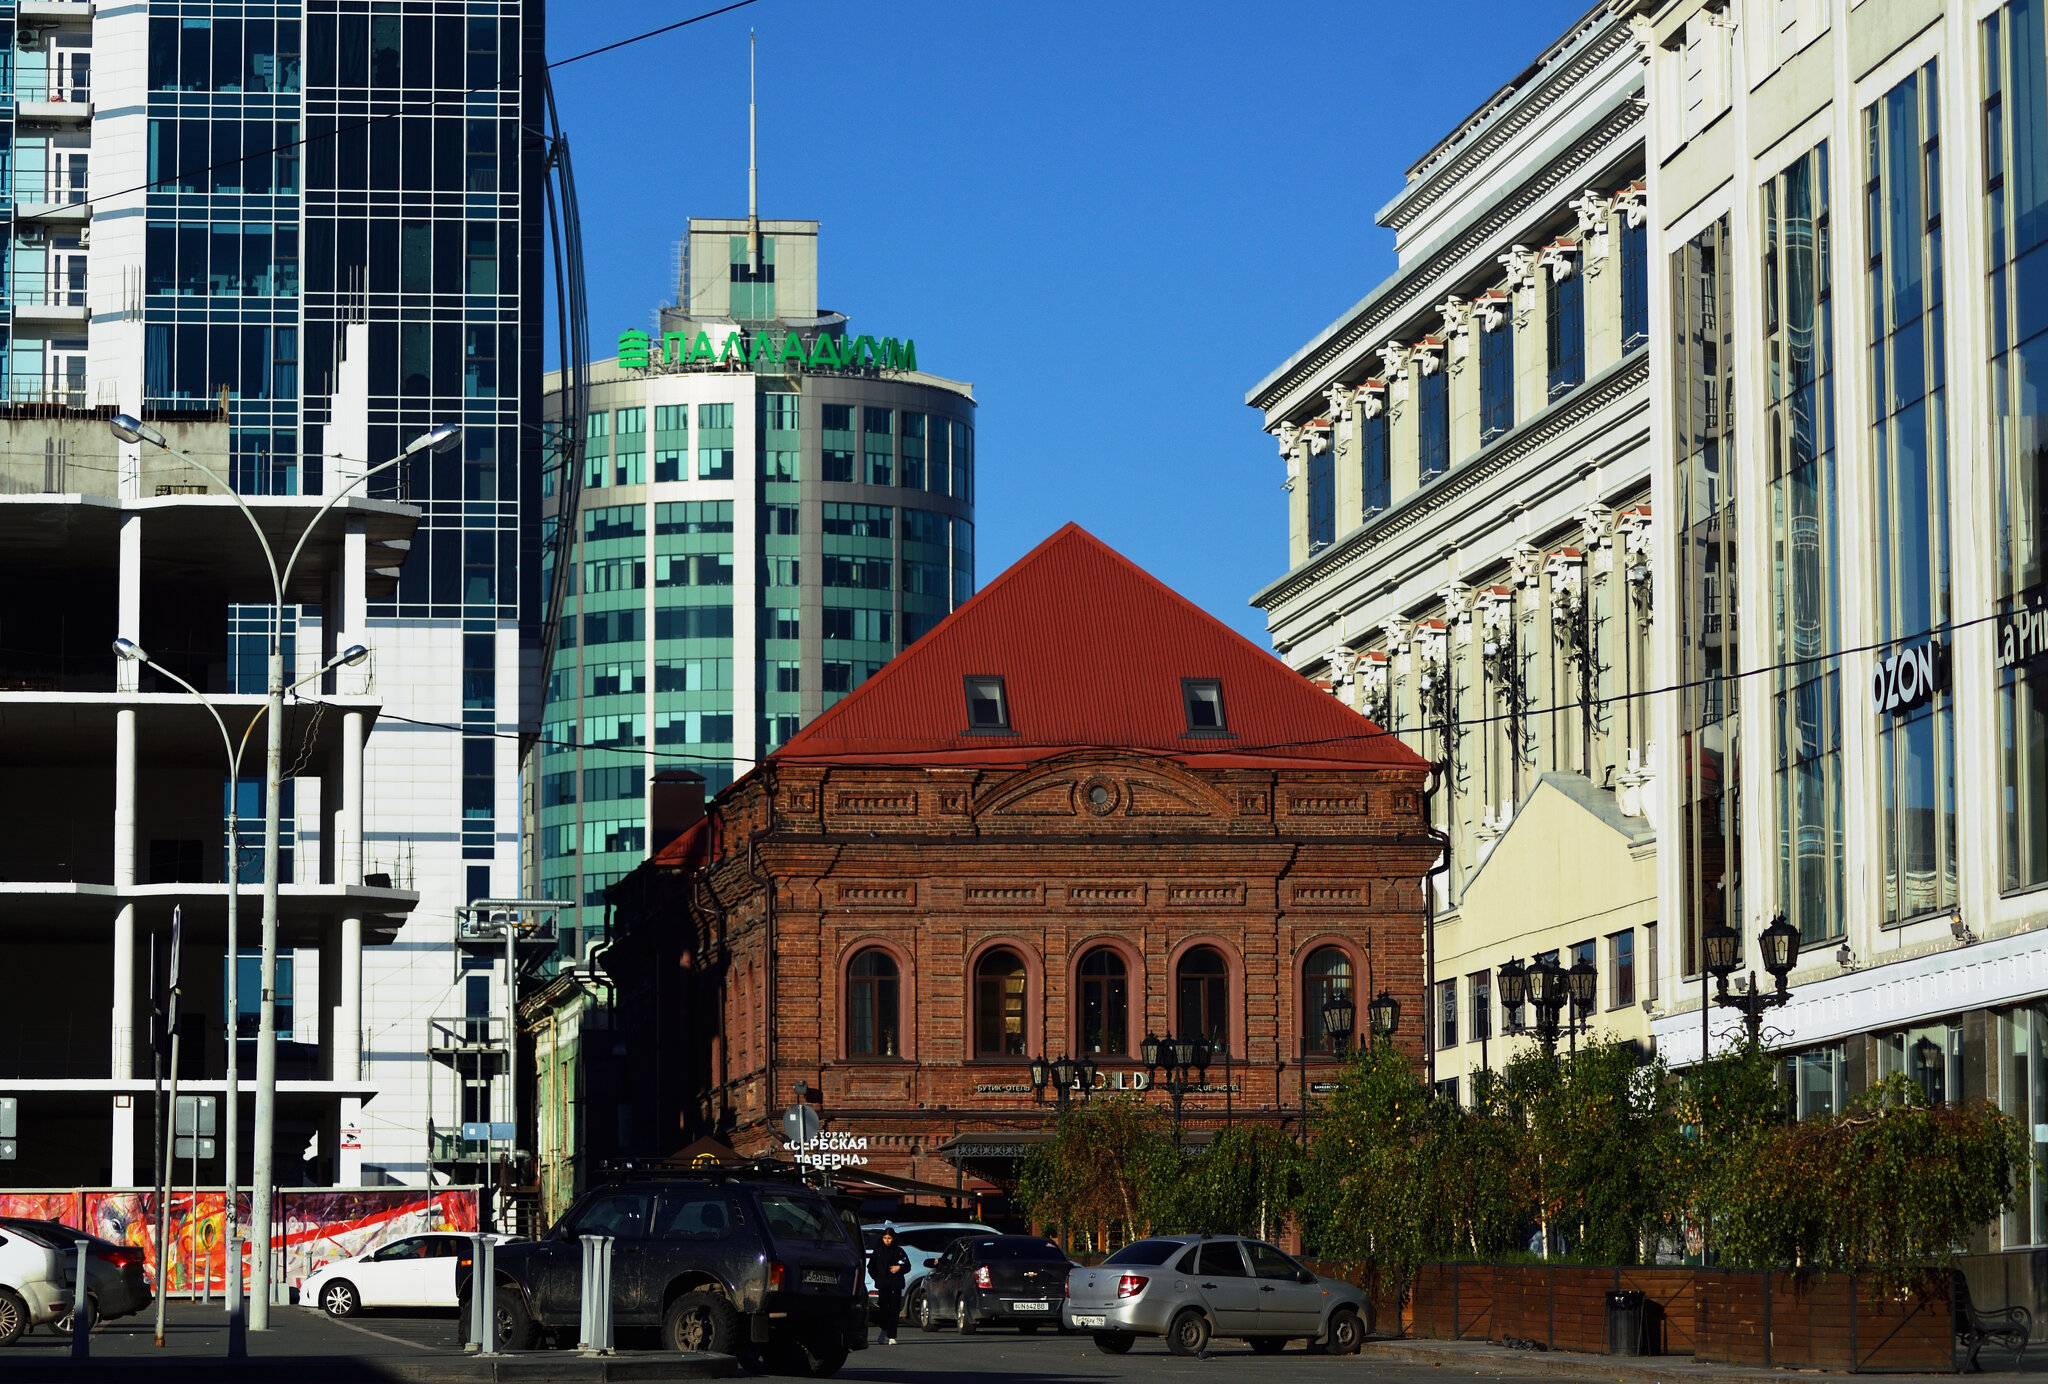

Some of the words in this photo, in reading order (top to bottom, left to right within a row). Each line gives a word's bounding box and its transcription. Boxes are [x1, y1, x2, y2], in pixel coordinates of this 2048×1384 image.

[663, 331, 917, 371] ПАЛЛАДИУМ
[1993, 612, 2015, 669] La
[1872, 641, 1933, 714] OZON
[814, 1131, 851, 1139] ТОРАН
